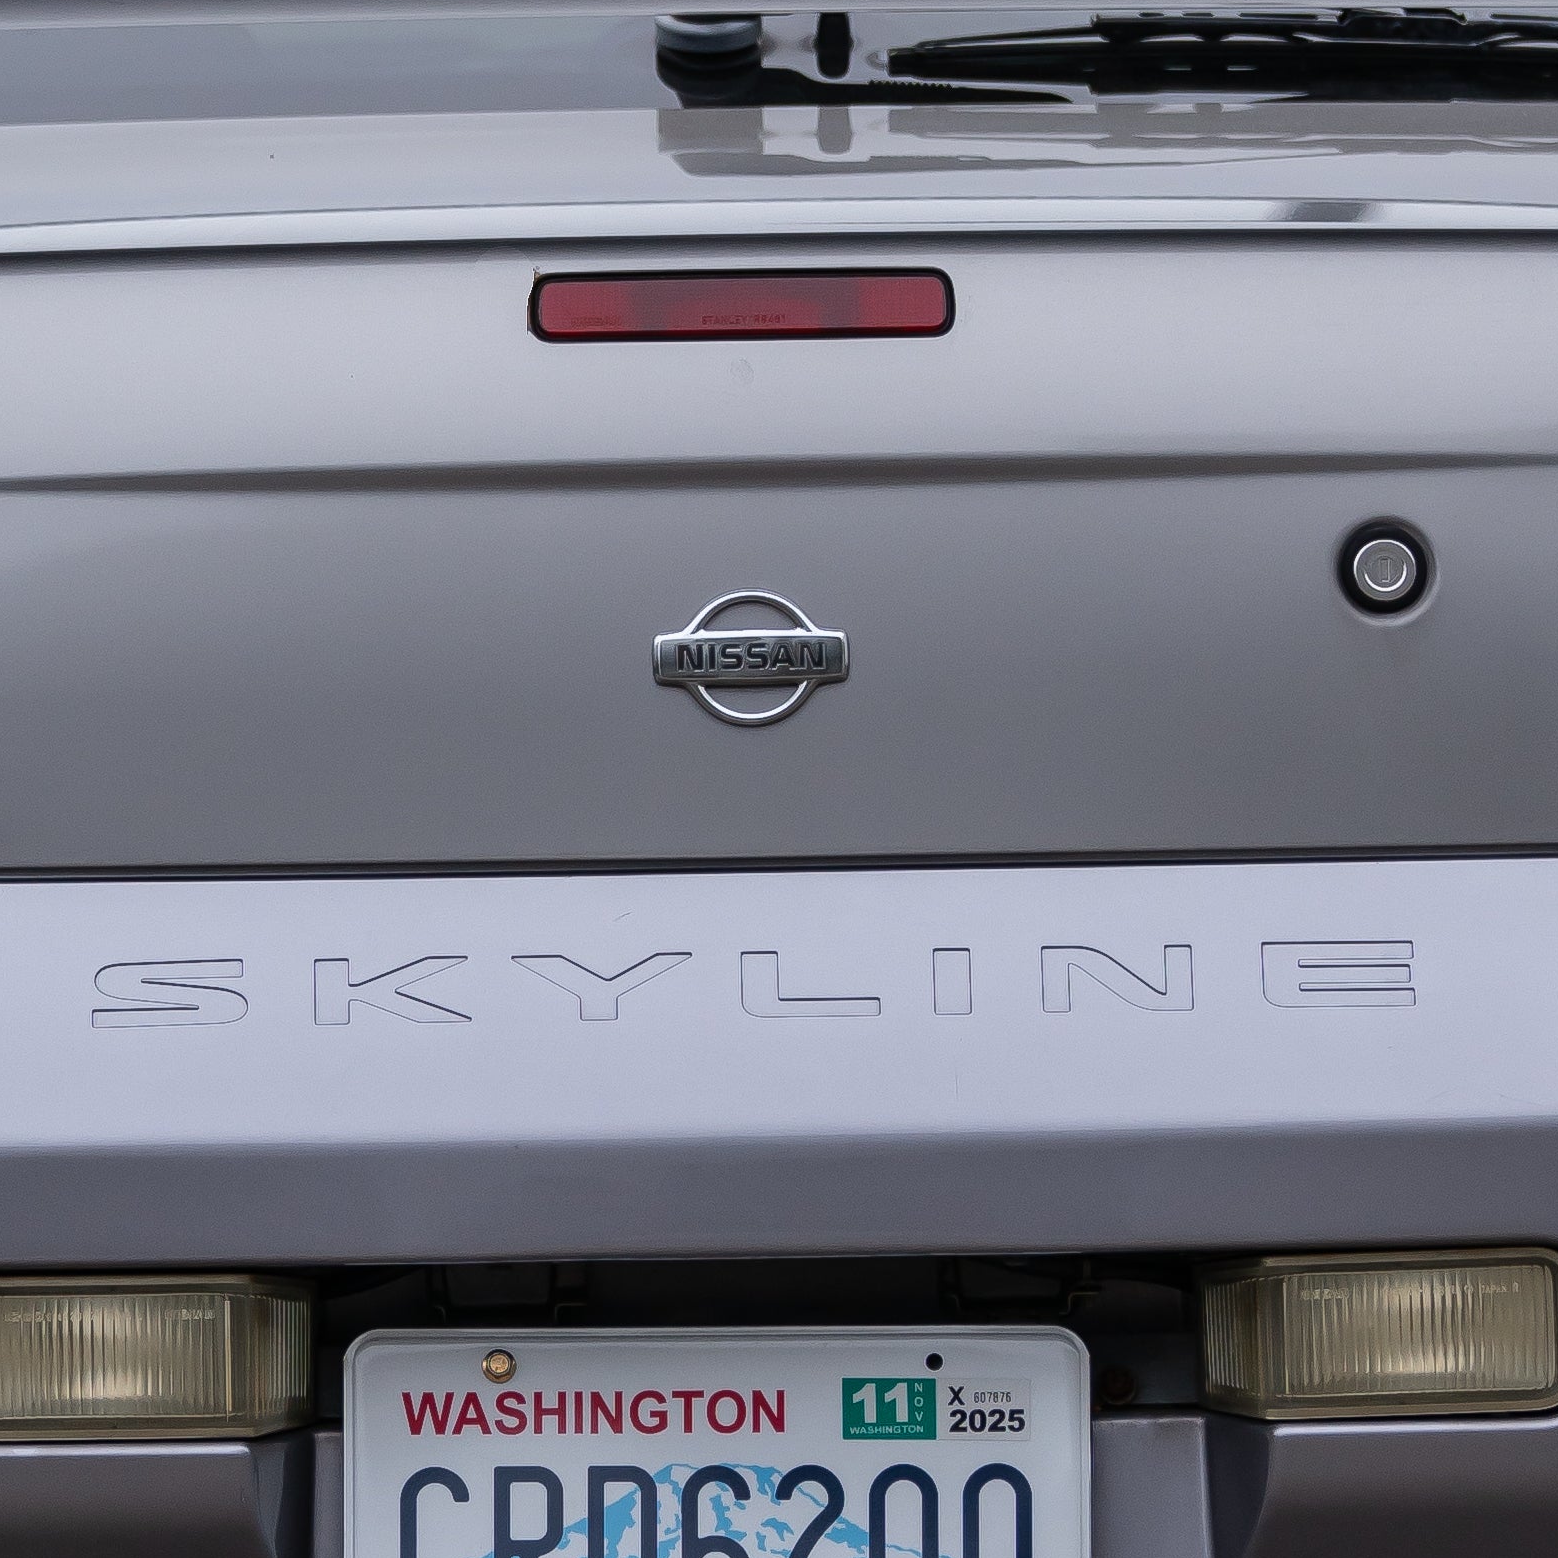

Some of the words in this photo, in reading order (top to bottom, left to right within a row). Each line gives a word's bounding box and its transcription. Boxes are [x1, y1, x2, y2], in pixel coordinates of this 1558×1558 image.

[676, 641, 826, 673] NISSAN
[91, 939, 1417, 1028] SKYLINE
[852, 1382, 909, 1424] 11
[947, 1385, 965, 1406] X
[400, 1389, 786, 1435] WASHINGTON
[949, 1409, 1026, 1433] 2025
[849, 1424, 925, 1435] WASHINGTON
